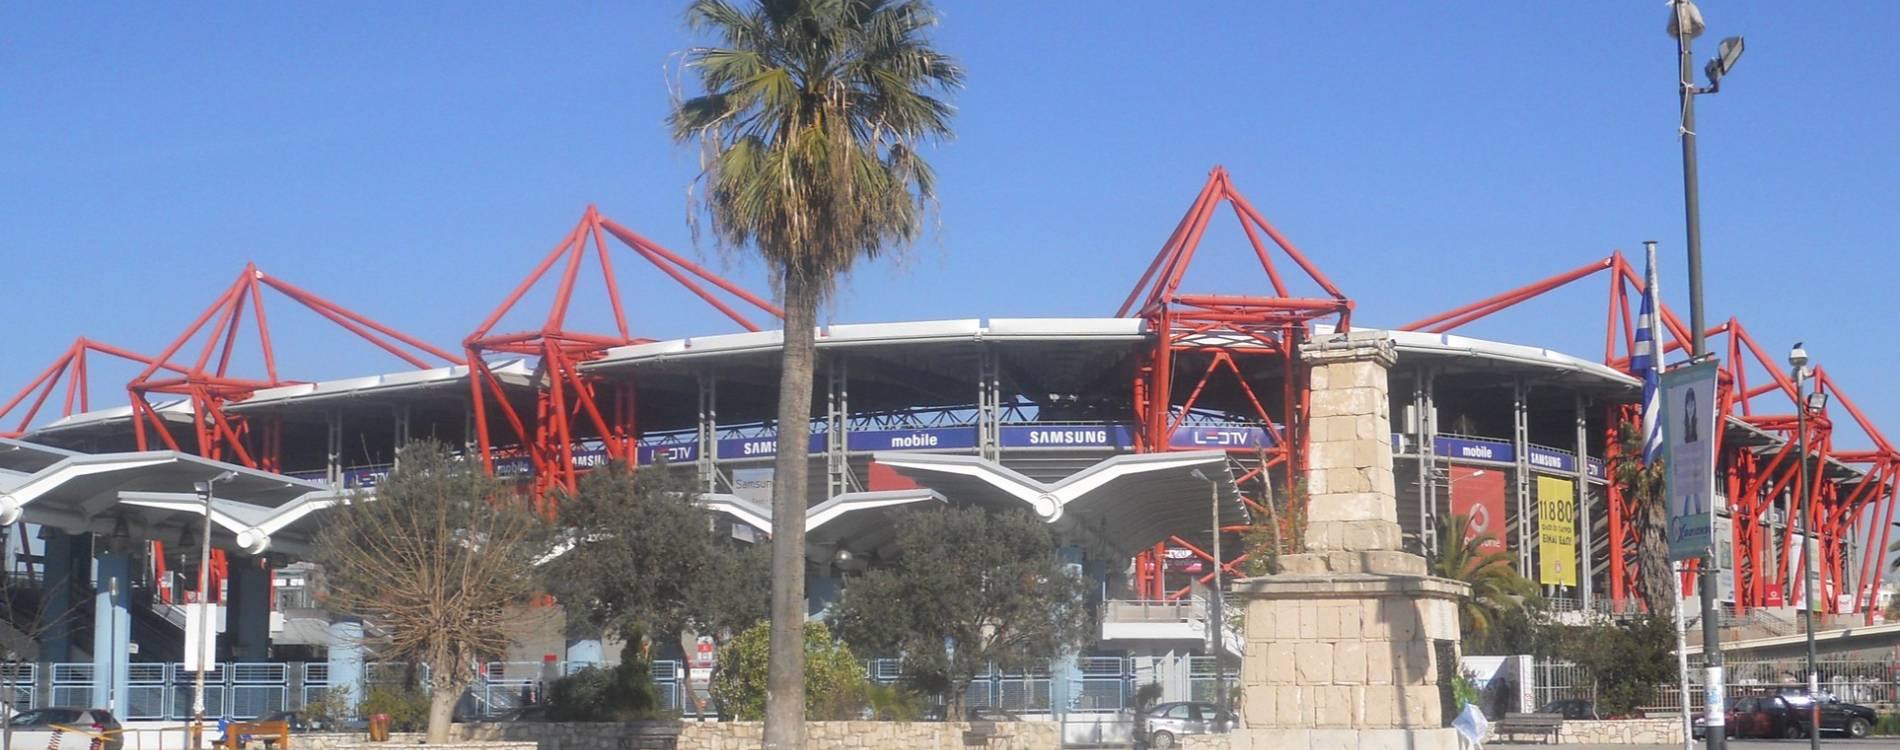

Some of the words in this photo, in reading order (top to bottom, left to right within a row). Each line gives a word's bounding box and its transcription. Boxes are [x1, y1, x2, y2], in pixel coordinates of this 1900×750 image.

[891, 434, 938, 447] mobile
[1030, 431, 1107, 444] SAMSUNG
[743, 440, 777, 455] SAMS
[1462, 445, 1493, 459] mobile
[1531, 452, 1562, 468] SAMSUNG
[736, 479, 773, 490] Samsun
[1540, 500, 1573, 524] 11880
